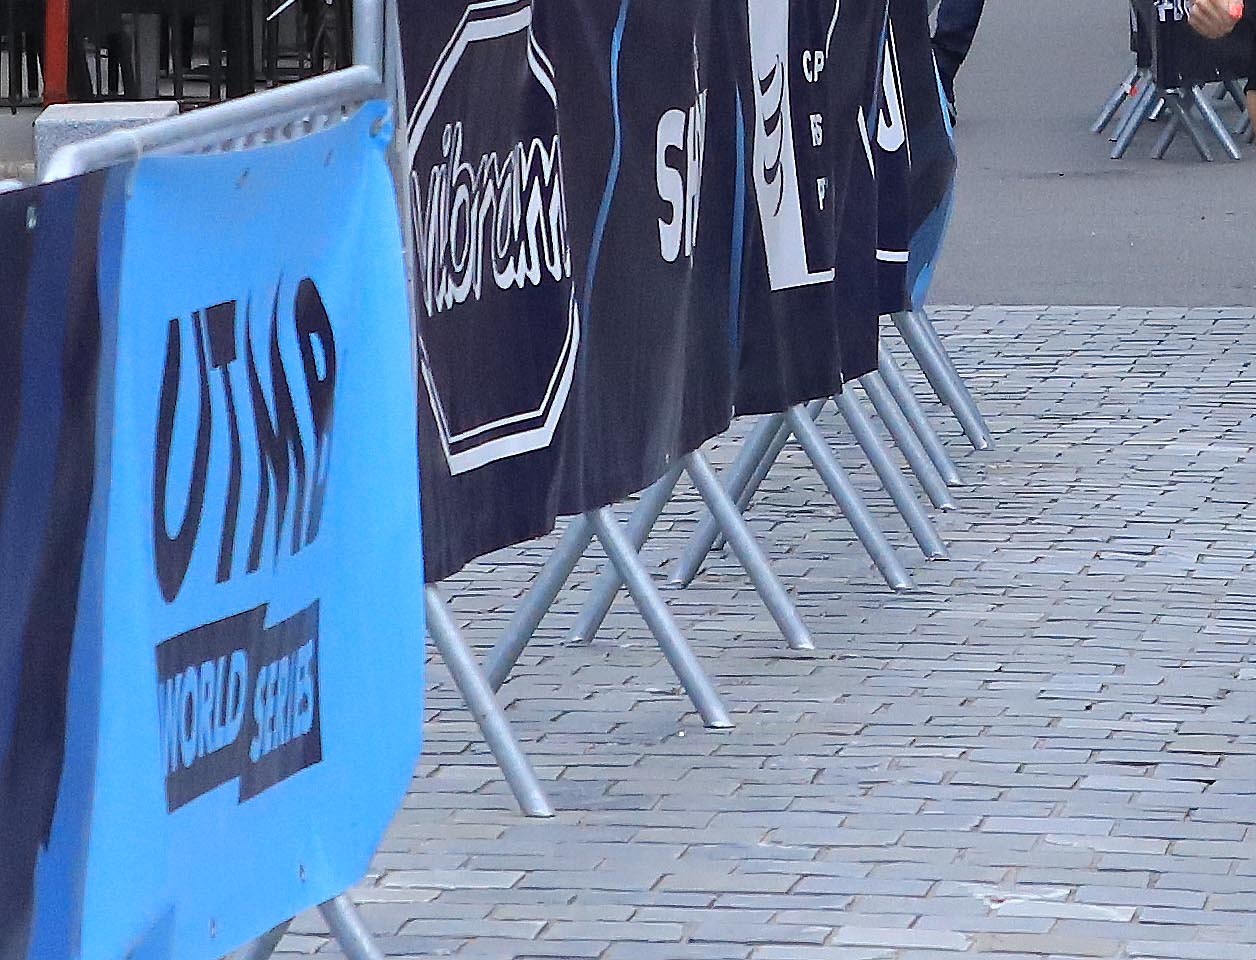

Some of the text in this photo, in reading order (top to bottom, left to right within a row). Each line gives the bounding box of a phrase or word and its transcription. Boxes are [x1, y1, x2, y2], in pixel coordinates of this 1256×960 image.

[153, 272, 336, 604] UTMB
[160, 649, 248, 776] WORLD
[249, 639, 315, 764] SERIES
